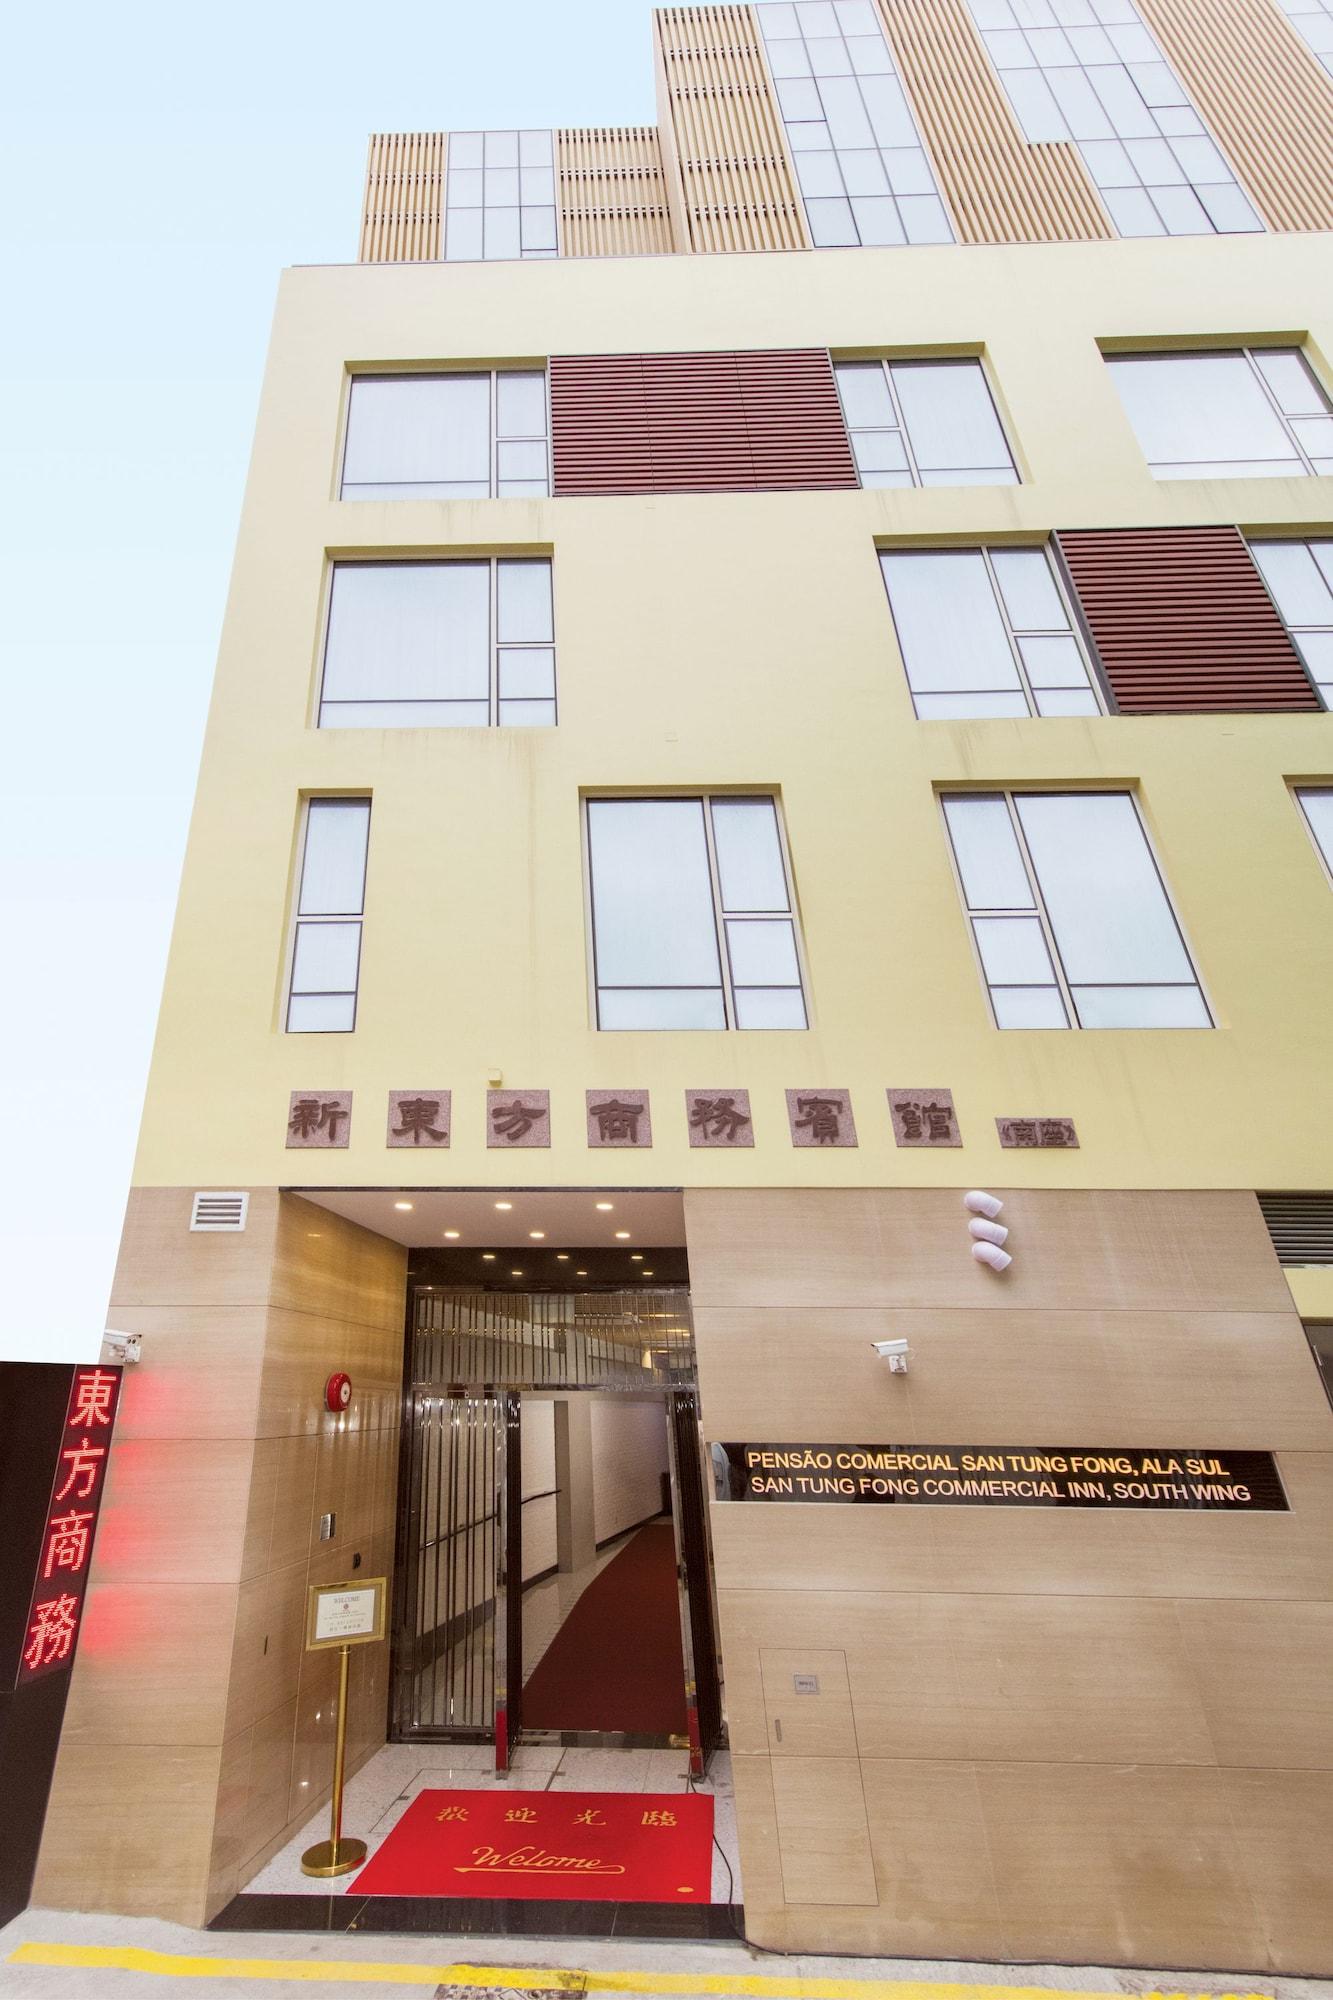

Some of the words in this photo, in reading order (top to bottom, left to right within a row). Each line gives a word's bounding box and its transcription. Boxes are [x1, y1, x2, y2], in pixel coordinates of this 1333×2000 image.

[748, 1450, 832, 1470] PENSÃO
[837, 1453, 959, 1472] COMERCIAL
[962, 1455, 1004, 1473] SAN
[1007, 1456, 1068, 1474] TUNG
[1070, 1457, 1139, 1477] FONG,
[1142, 1459, 1184, 1475] ALA
[1187, 1459, 1230, 1476] SUL
[752, 1477, 793, 1494] SAN
[796, 1477, 855, 1495] TUNG
[860, 1479, 919, 1496] FONG
[923, 1479, 1066, 1498] COMMERCIAL
[1069, 1482, 1112, 1501] INN,
[1114, 1483, 1188, 1500] SOUTH
[1191, 1484, 1251, 1501] WING
[24, 1369, 117, 1670] 東方商務
